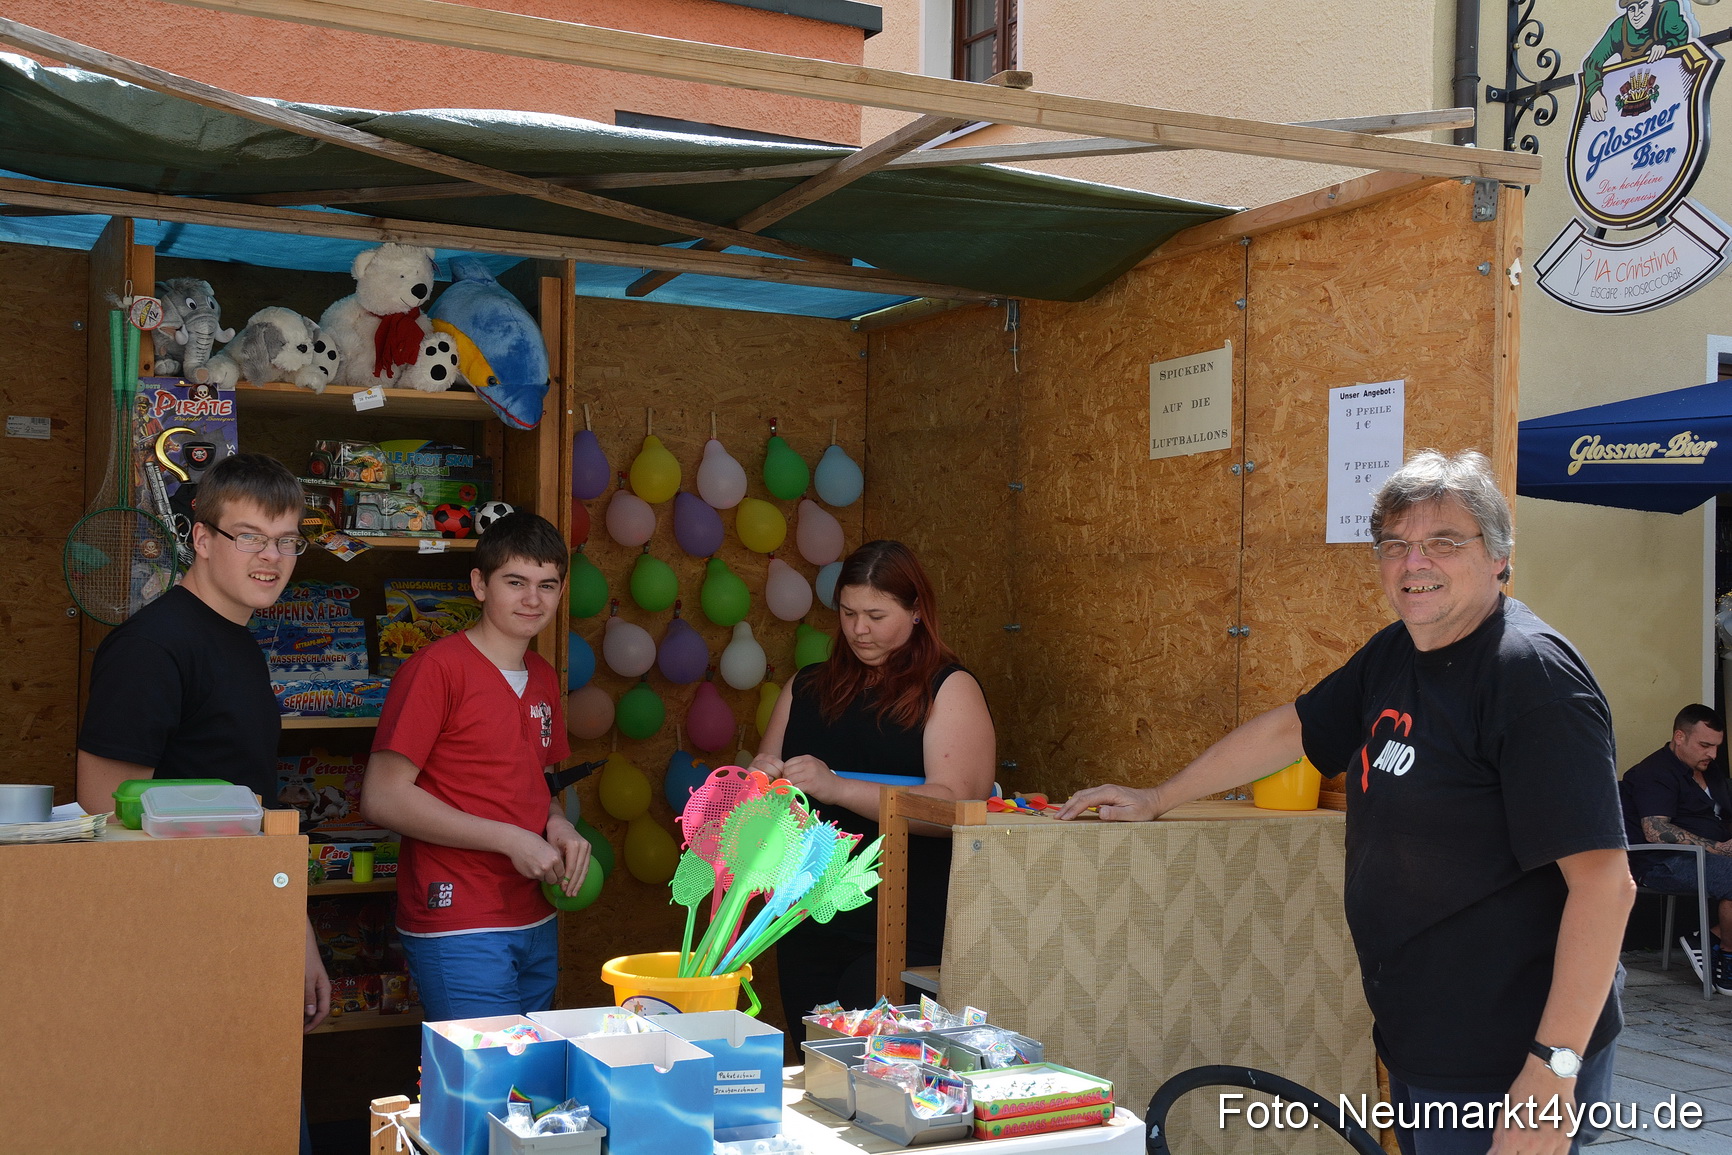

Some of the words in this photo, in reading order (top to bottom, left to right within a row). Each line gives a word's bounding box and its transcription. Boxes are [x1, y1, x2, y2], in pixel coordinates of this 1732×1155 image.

[1586, 102, 1681, 182] Glossner
[1632, 142, 1676, 170] Bier
[1596, 178, 1617, 195] Der
[1618, 171, 1665, 191] hochfeine
[1601, 191, 1657, 209] Biergenuss
[1615, 246, 1678, 283] Christina
[1159, 361, 1214, 381] SPICKERN
[154, 389, 232, 418] PIRATE
[1339, 392, 1360, 401] Unser
[1162, 401, 1183, 414] AUF
[1191, 397, 1211, 409] DIE
[1345, 408, 1352, 417] 3
[1356, 405, 1392, 416] PFEILE
[1355, 421, 1361, 430] 1
[1364, 420, 1371, 429] €
[1152, 428, 1228, 449] LUFTBALLONS
[406, 451, 442, 466] FOOT
[1567, 430, 1718, 476] Glossner-Bier
[1344, 462, 1351, 471] 7
[1354, 460, 1390, 470] PFEILE
[1354, 475, 1361, 483] 2
[1365, 474, 1371, 483] €
[1339, 515, 1351, 524] 15
[1353, 529, 1360, 537] 4
[1364, 528, 1372, 537] €
[292, 587, 310, 599] 24
[390, 581, 454, 592] DINOSAURES
[255, 601, 315, 621] SERPENTS
[328, 603, 349, 619] EAU
[269, 654, 347, 663] WASSERSCHLANGEN
[283, 690, 335, 712] SERPENTS
[345, 693, 364, 709] EAU
[275, 761, 294, 771] âte
[298, 756, 364, 775] Péteuse
[1372, 739, 1416, 777] AWO
[319, 845, 349, 859] Pâte
[344, 979, 356, 987] 36
[1002, 1100, 1046, 1114] BAGUES
[1004, 1118, 1047, 1135] BAGUES
